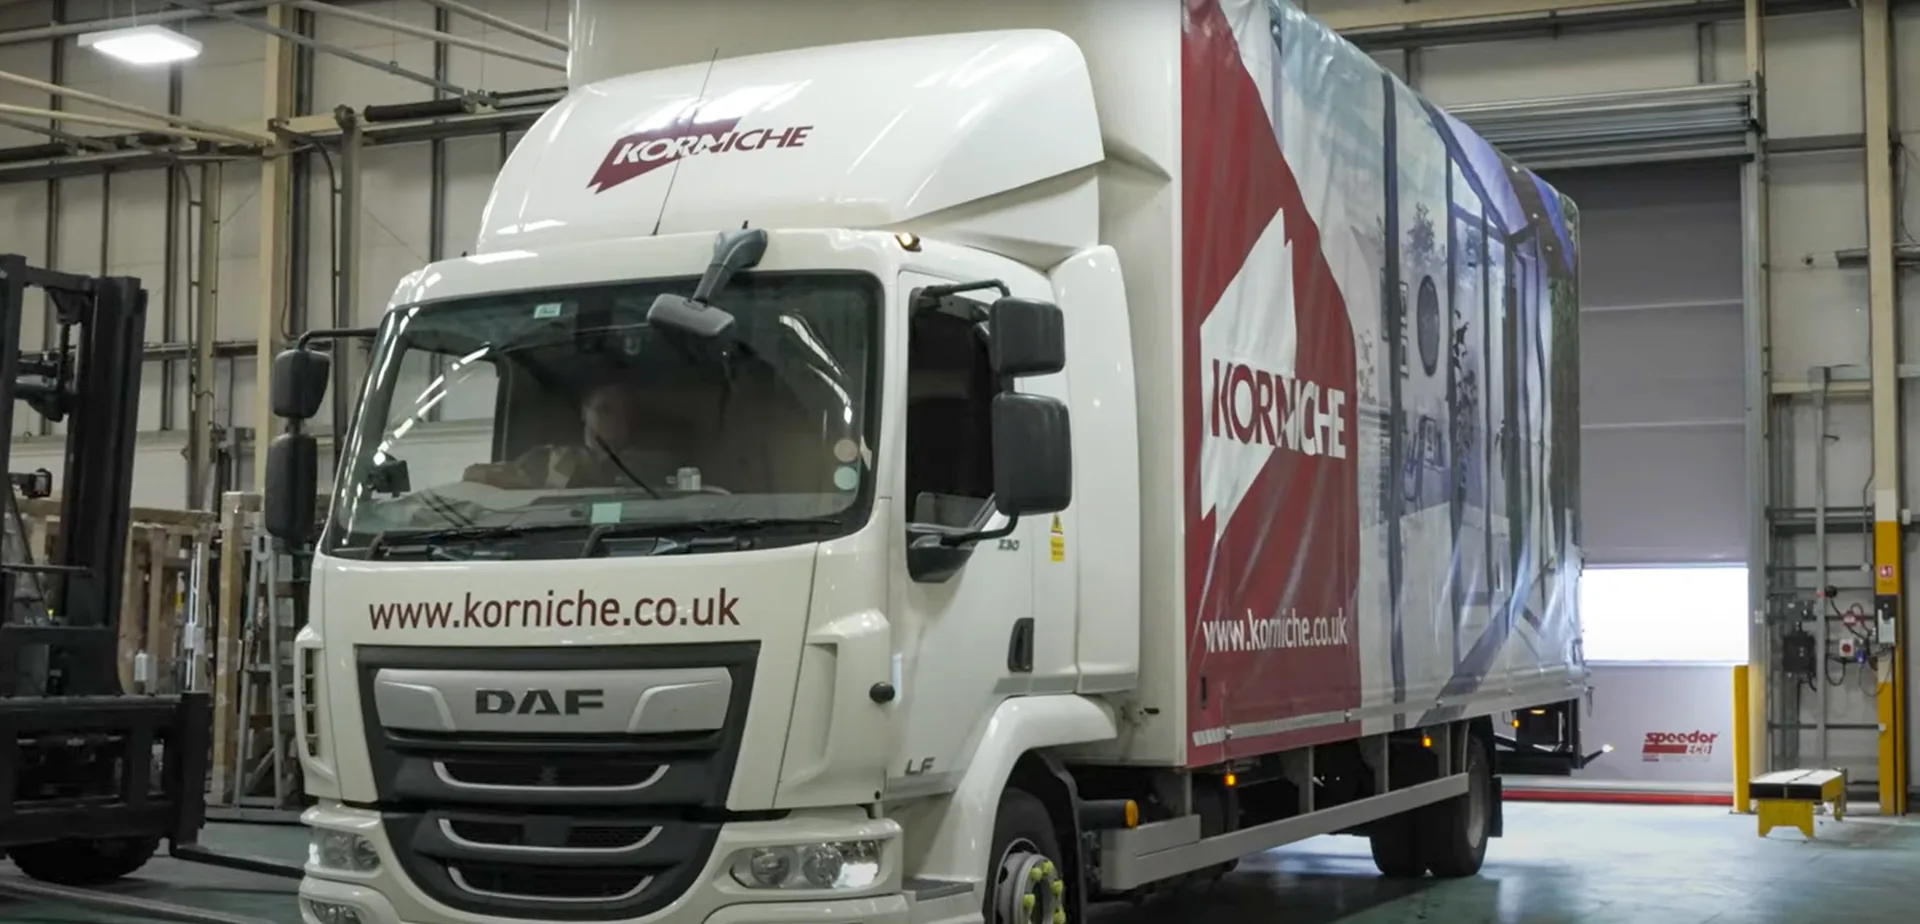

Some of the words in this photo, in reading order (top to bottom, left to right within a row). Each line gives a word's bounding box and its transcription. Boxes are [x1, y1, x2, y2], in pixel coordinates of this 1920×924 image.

[612, 126, 814, 165] KORNICHE
[1211, 358, 1346, 459] KORNICHE
[369, 588, 740, 630] www.korniche.co.uk
[1202, 607, 1348, 652] www.korniche.co.uk
[475, 689, 604, 715] DAF
[1645, 730, 1718, 746] speedor
[904, 757, 936, 776] LF
